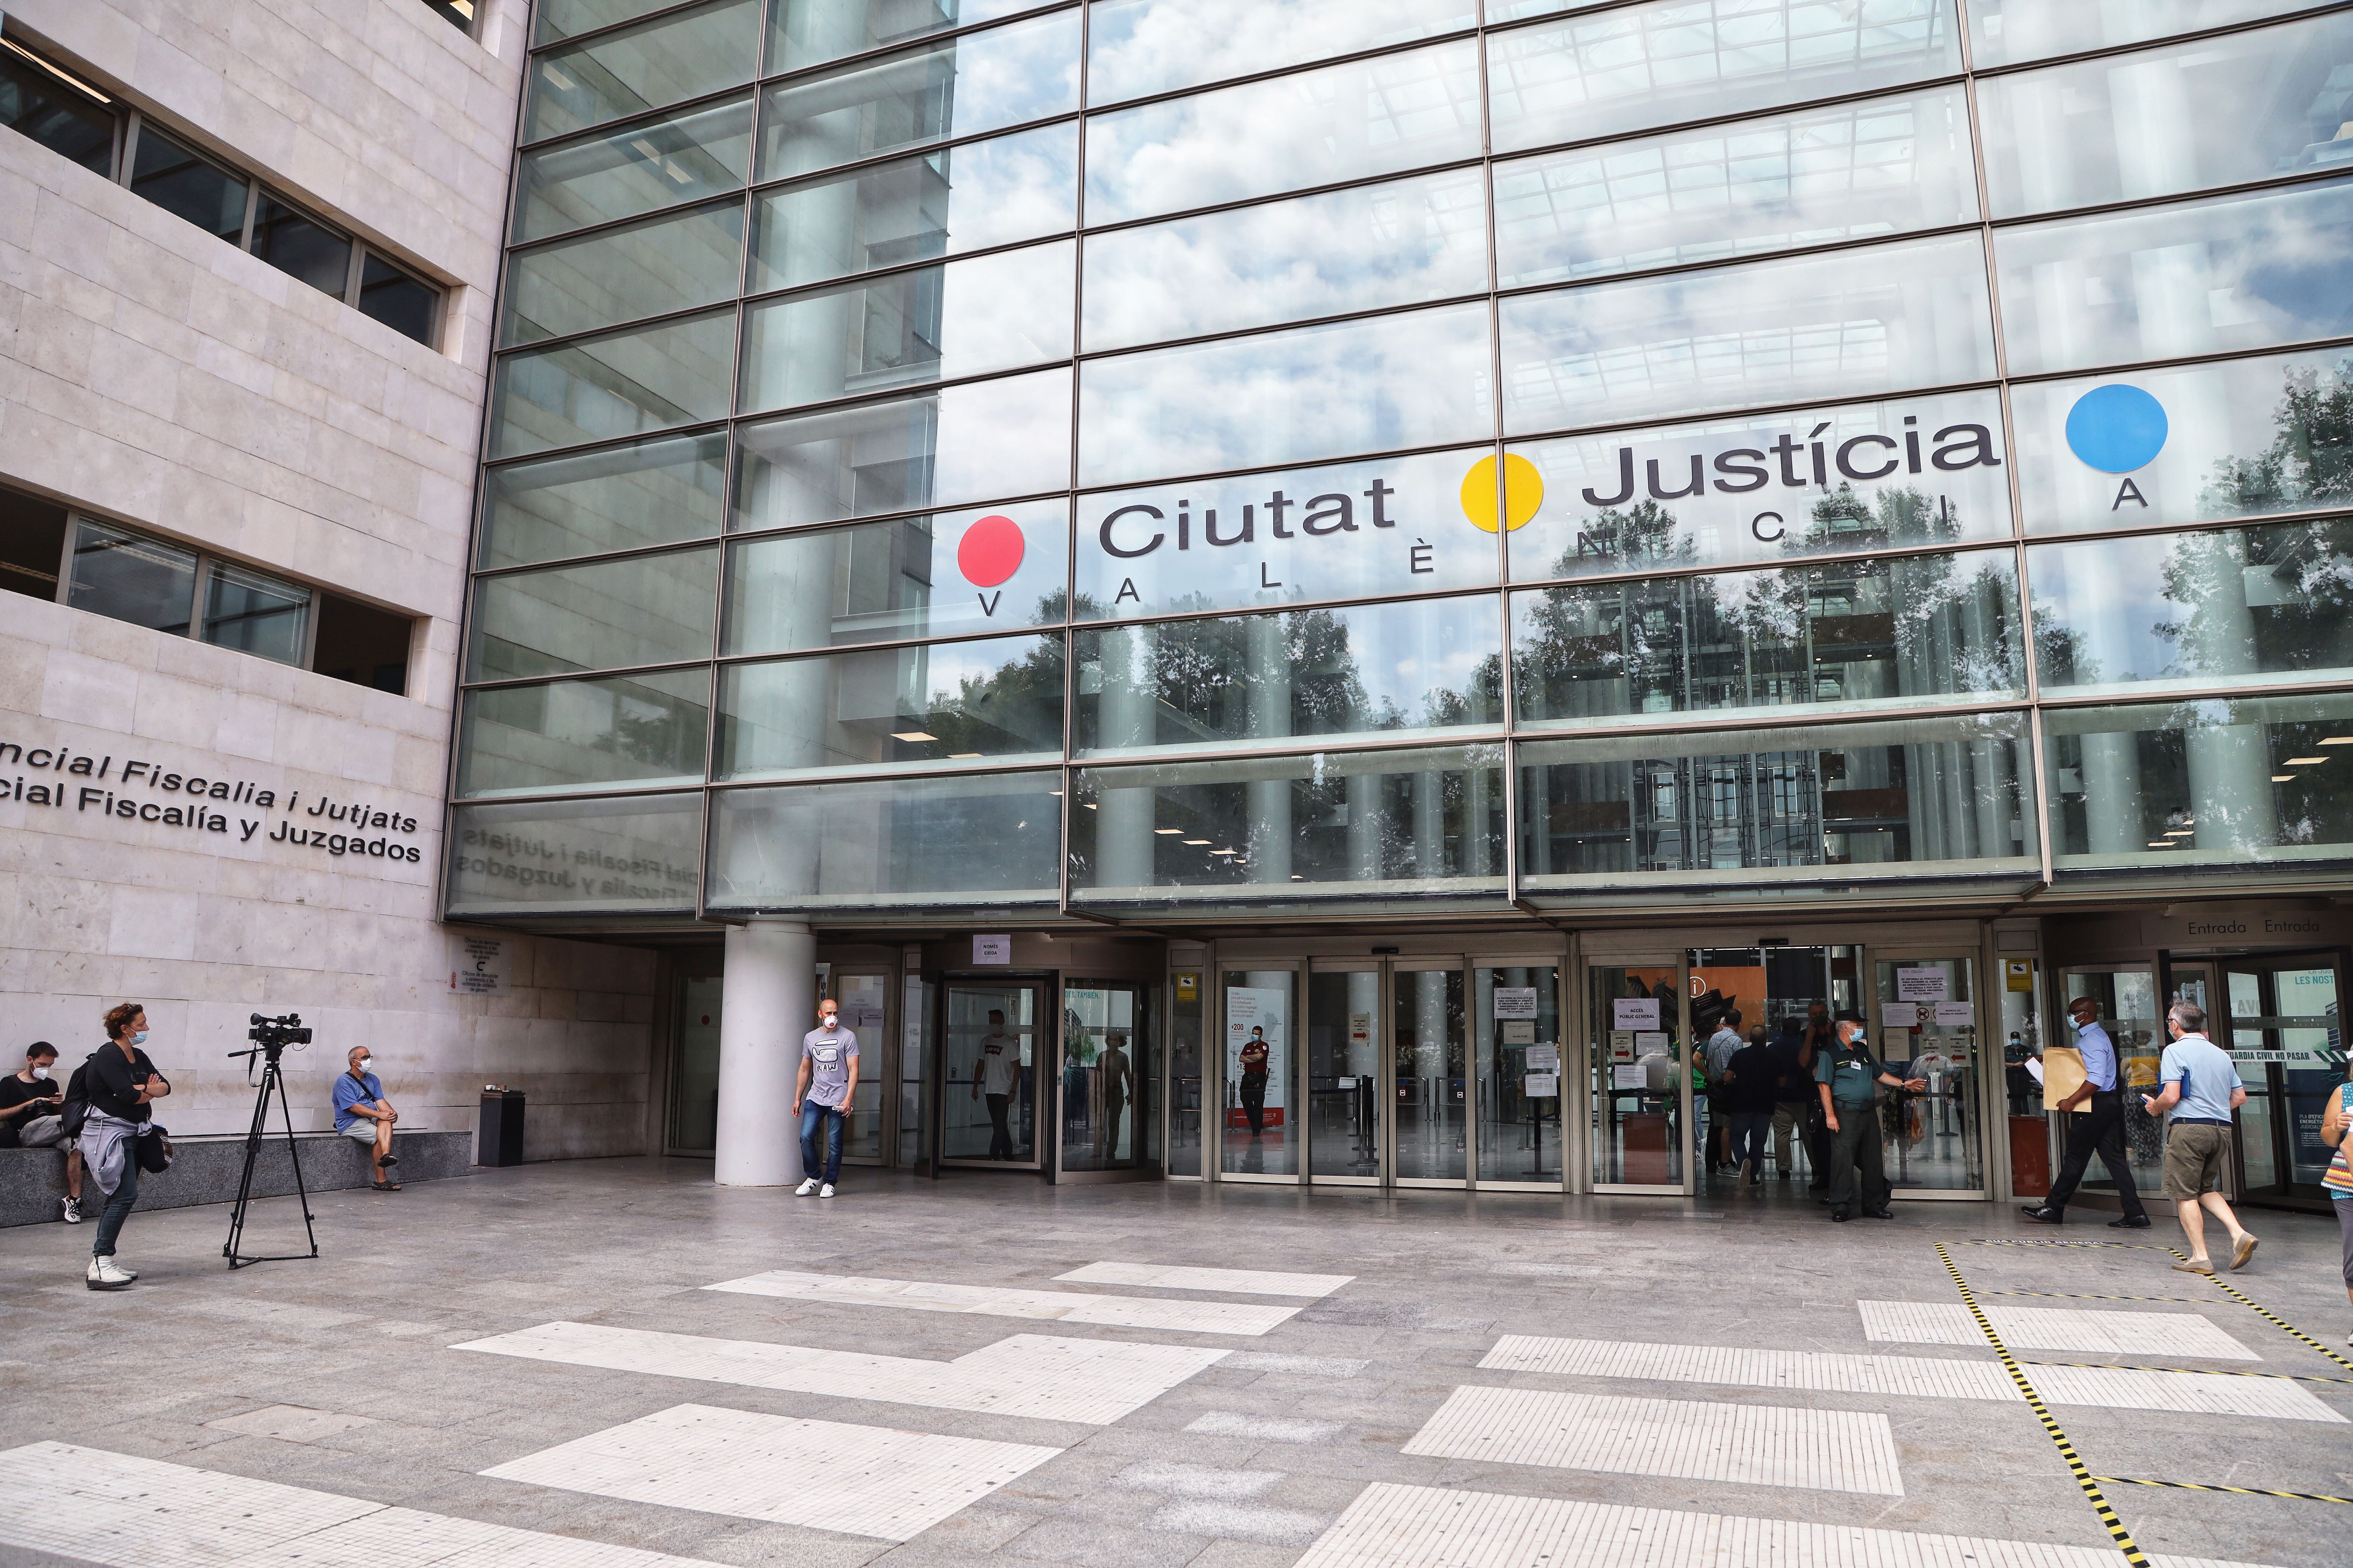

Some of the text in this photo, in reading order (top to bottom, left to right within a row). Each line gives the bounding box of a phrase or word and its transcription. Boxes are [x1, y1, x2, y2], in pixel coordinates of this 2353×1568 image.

[1099, 416, 2001, 558] Ciutat Justícia
[0, 742, 417, 833] ncial Fiscalia i Jutjats
[78, 787, 227, 833] Fiscalía
[240, 819, 259, 842] y
[269, 820, 420, 862] Juzgados
[2188, 918, 2319, 935] Entrada Entrada
[2295, 976, 2310, 985] LES
[1077, 991, 1100, 999] TAMBIÉN.
[2257, 1052, 2273, 1060] CIVIL
[817, 1062, 836, 1071] RAW
